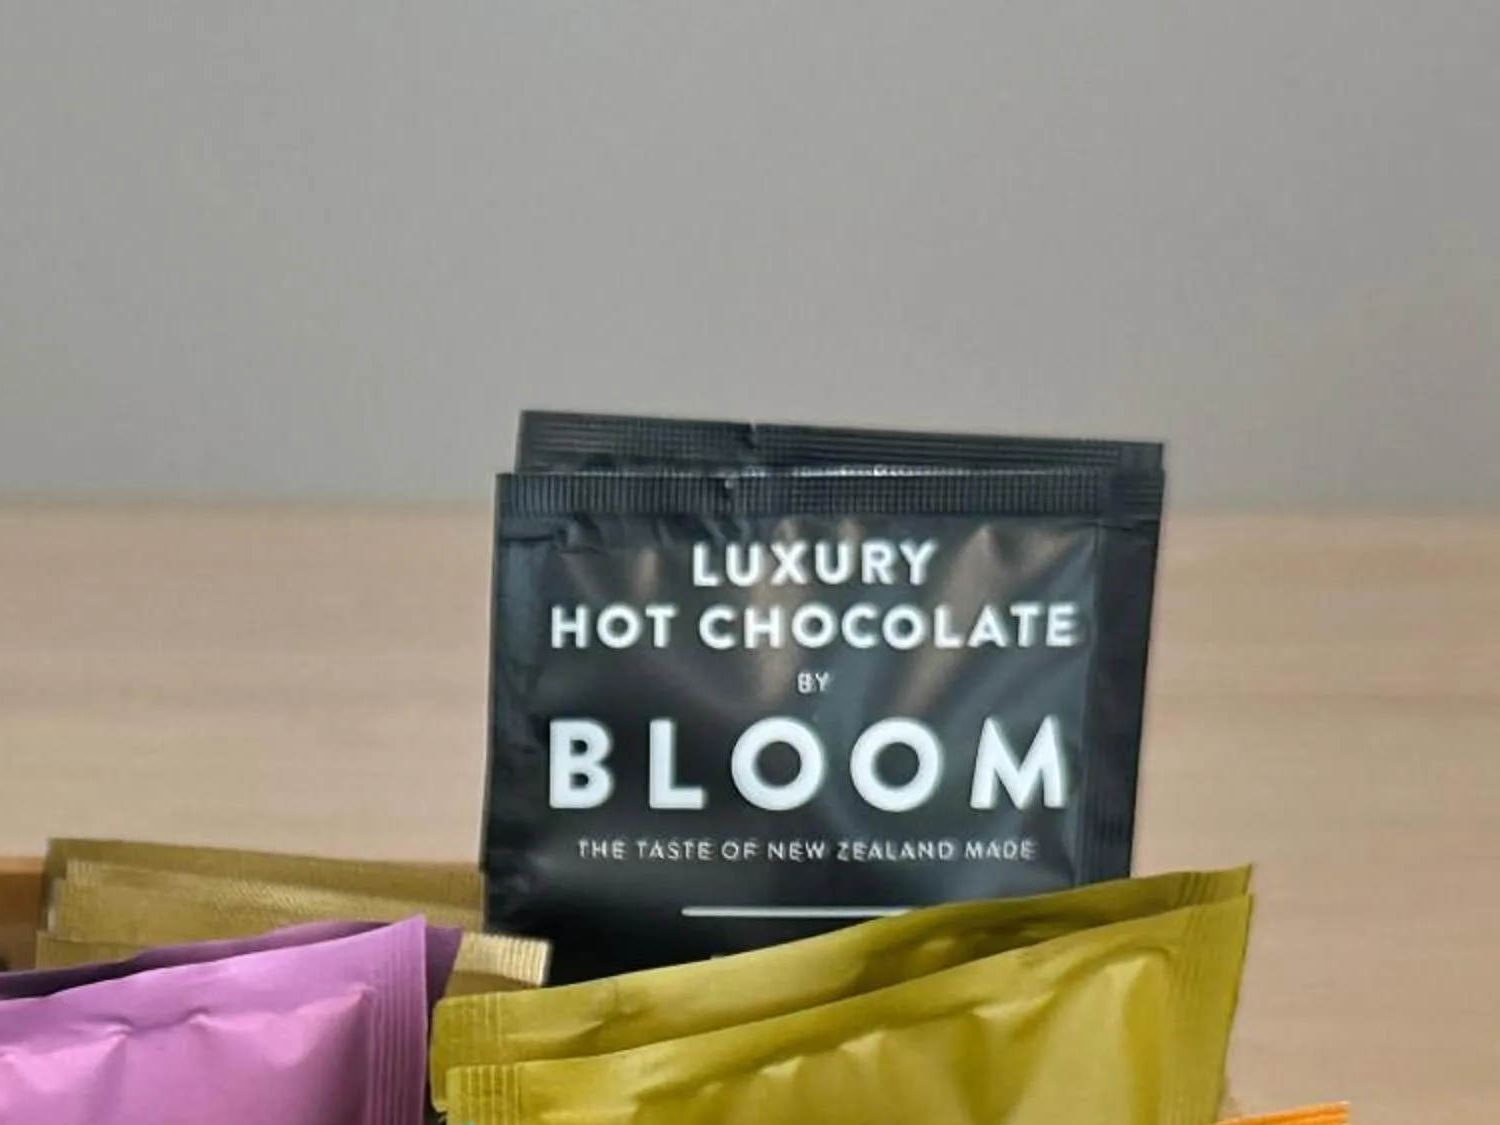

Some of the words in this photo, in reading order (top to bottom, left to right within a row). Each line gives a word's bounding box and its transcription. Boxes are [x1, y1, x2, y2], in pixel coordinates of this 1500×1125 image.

[690, 540, 938, 588] LUXURY
[550, 604, 678, 649] HOT
[698, 602, 1078, 650] CHOCOLATE
[796, 671, 831, 695] BY
[548, 714, 1067, 813] BLOOM
[577, 838, 627, 861] THE
[635, 839, 713, 862] TASTE
[721, 840, 758, 861] OF
[767, 841, 827, 862] NEW
[836, 839, 956, 862] ZEALAND
[964, 838, 1037, 861] MADE
